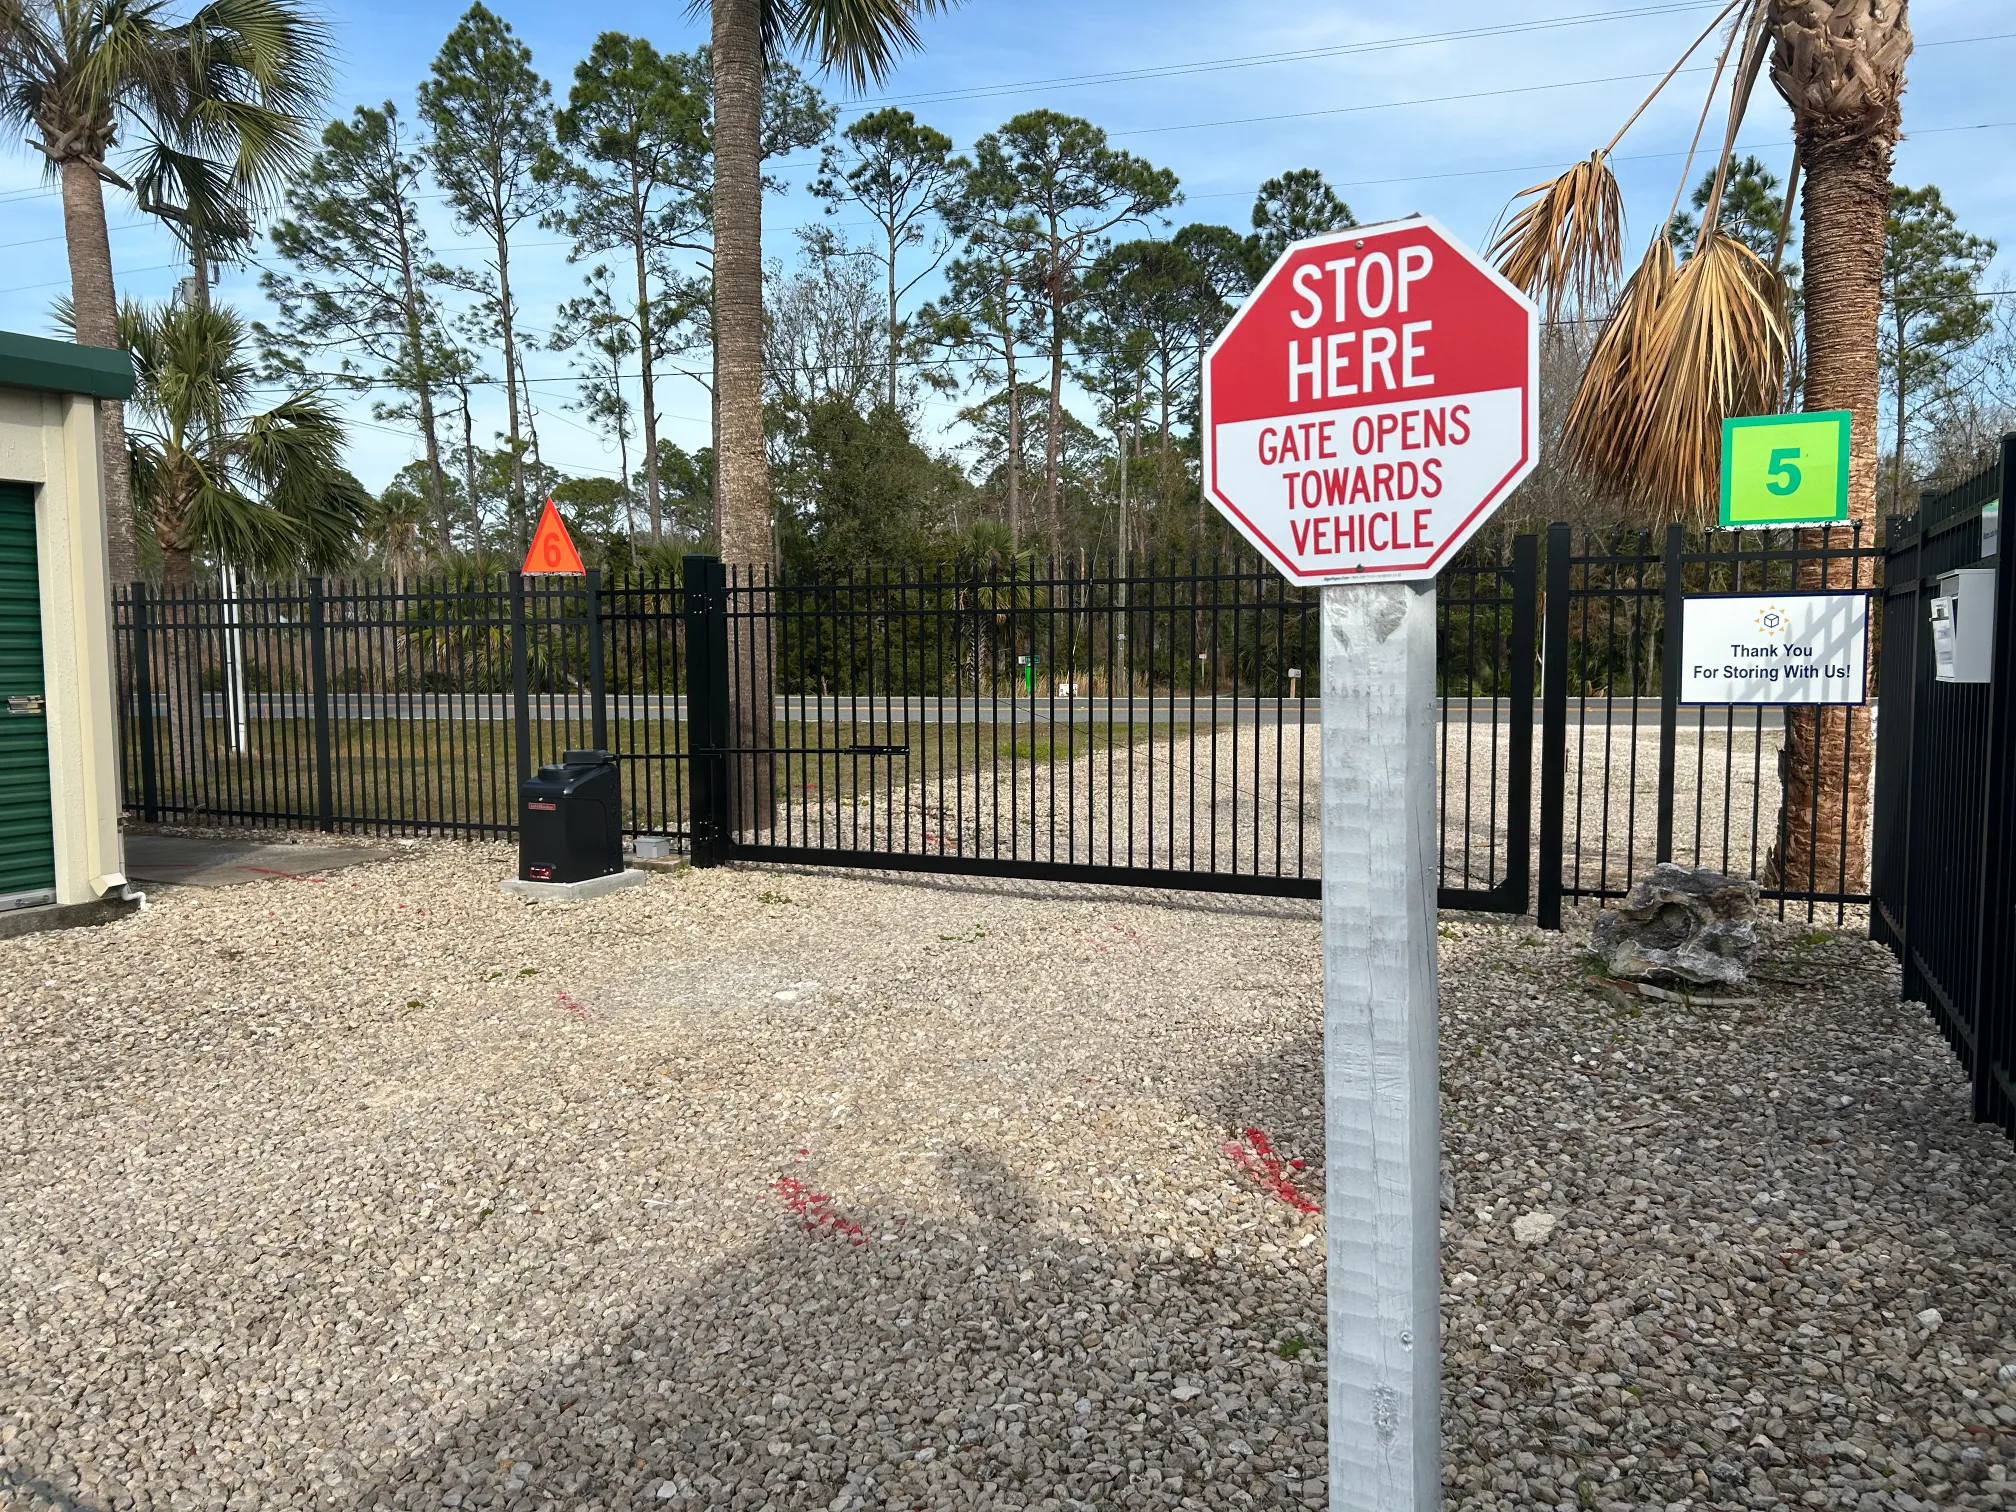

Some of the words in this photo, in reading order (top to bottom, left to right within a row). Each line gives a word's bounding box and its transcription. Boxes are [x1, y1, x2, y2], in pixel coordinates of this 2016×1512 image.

[1290, 244, 1433, 329] STOP
[1288, 320, 1435, 402] HERE
[1258, 420, 1337, 466] GATE
[1352, 404, 1471, 455] OPENS
[1283, 458, 1442, 510] TOWARDS
[1765, 447, 1802, 496] 5
[544, 532, 561, 568] 6
[1290, 508, 1434, 556] VEHICLE
[1693, 665, 1719, 679] For
[1723, 665, 1779, 682] Storing
[1783, 664, 1819, 679] With
[1824, 664, 1851, 678] Us!
[1730, 644, 1779, 658] Thank
[1783, 643, 1813, 657] You
